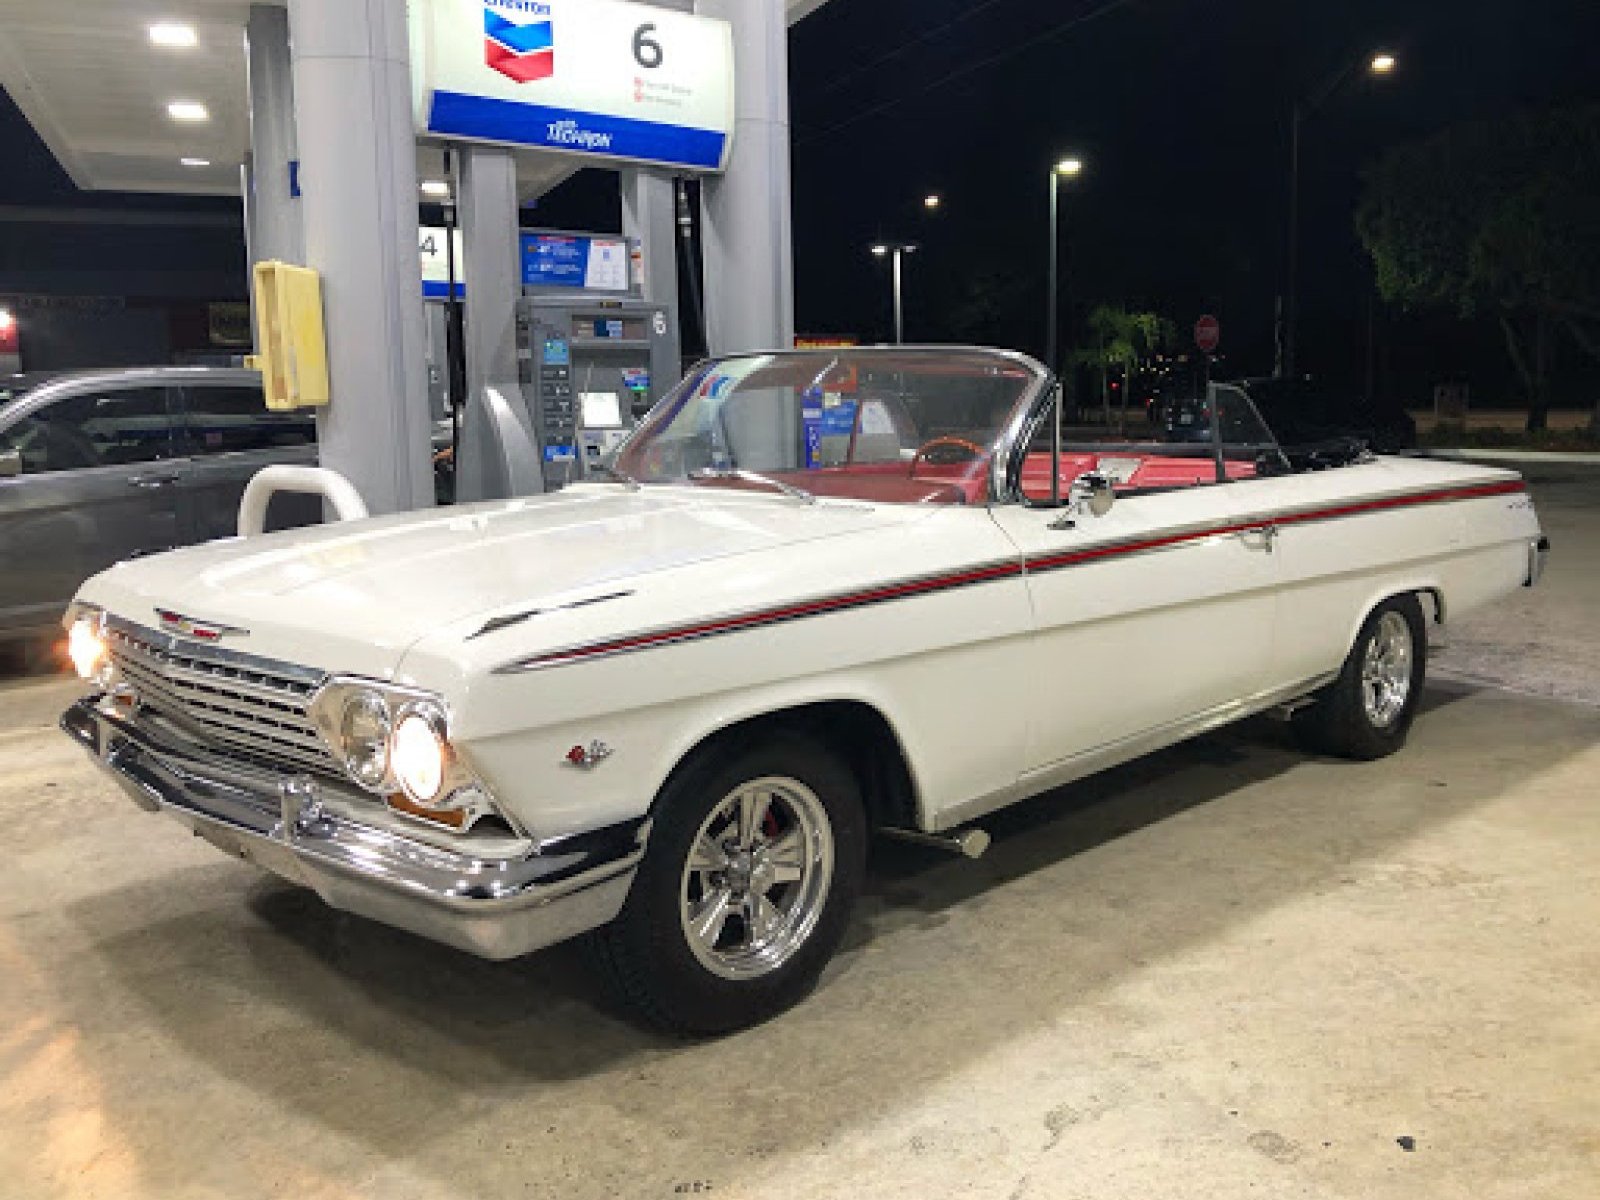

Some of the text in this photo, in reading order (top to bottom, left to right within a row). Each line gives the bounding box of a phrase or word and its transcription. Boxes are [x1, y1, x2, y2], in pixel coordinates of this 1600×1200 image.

[633, 23, 663, 68] 6
[420, 235, 437, 256] 4
[652, 311, 667, 335] 6
